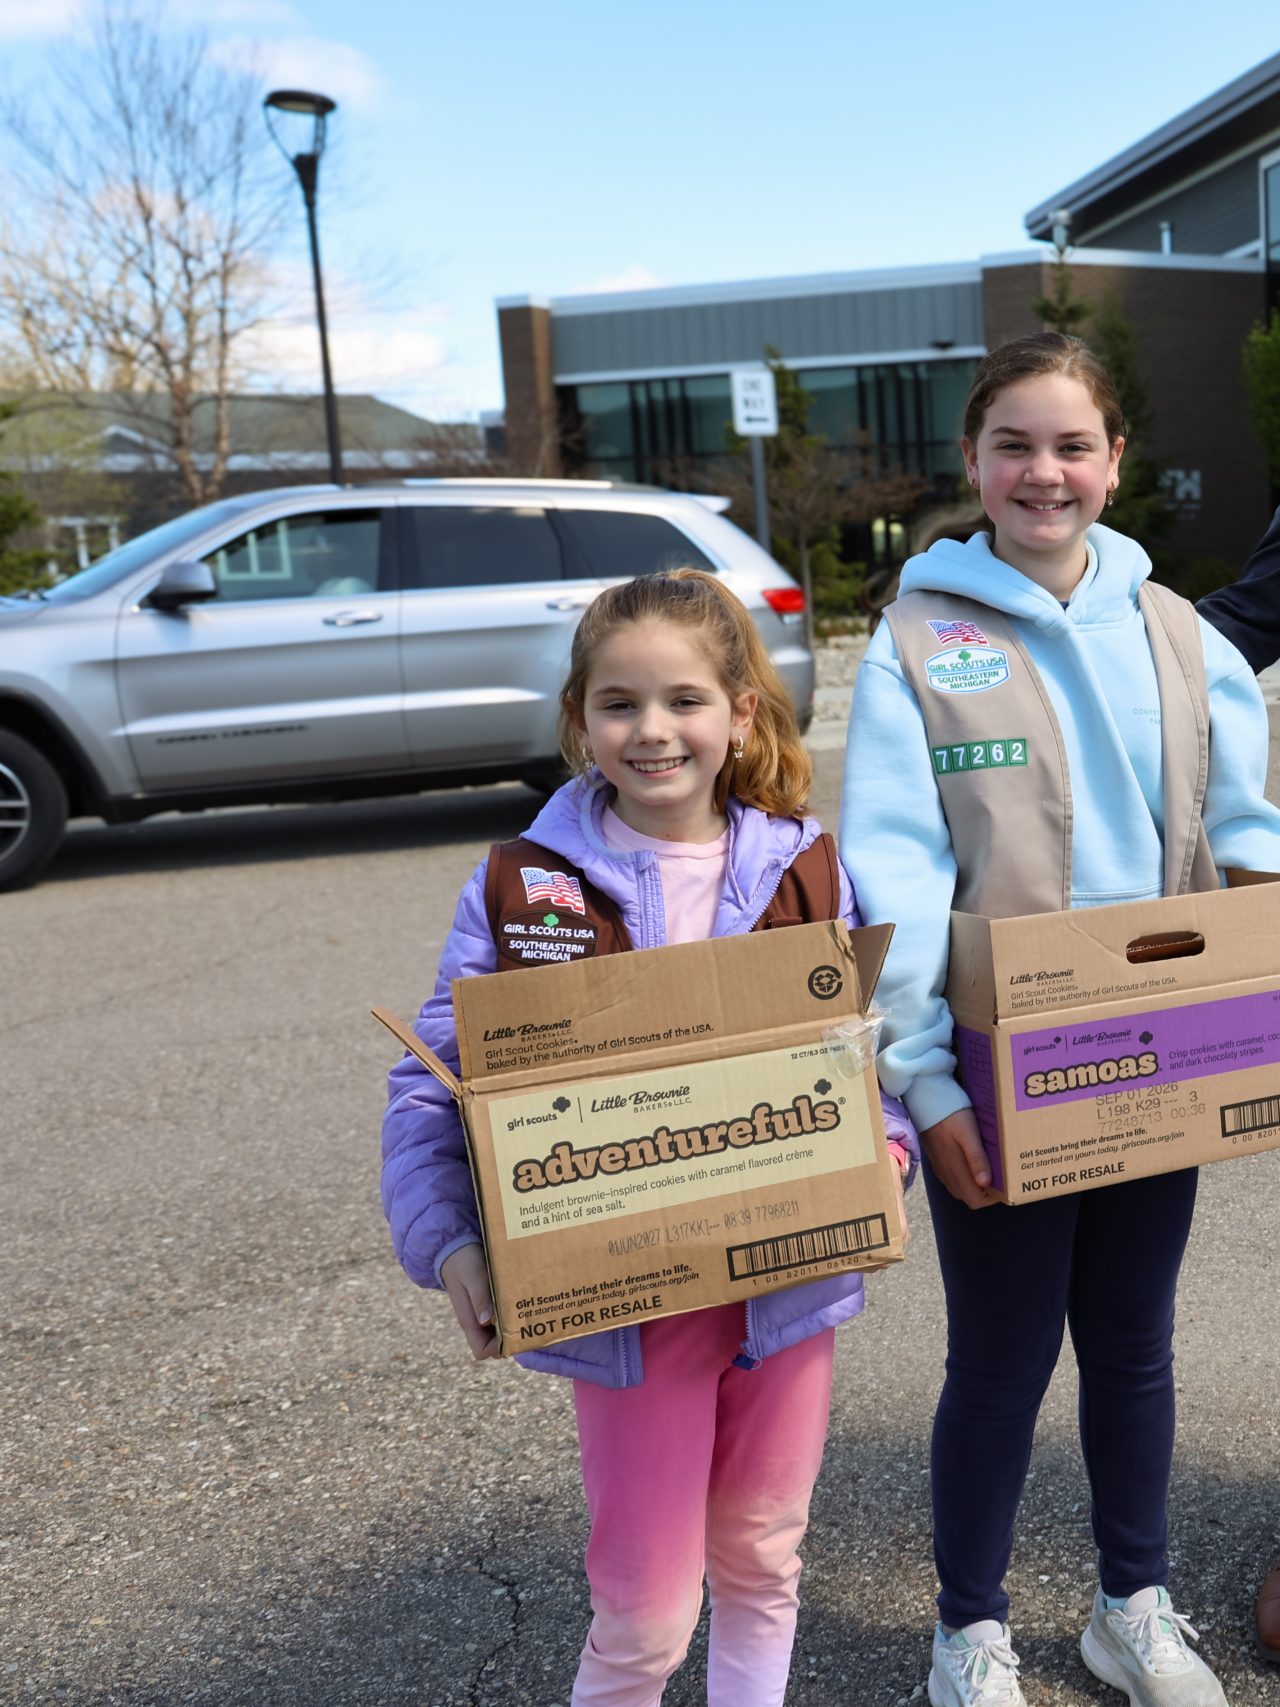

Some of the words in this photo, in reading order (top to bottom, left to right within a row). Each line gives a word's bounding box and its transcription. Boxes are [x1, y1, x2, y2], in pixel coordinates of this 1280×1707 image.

[929, 664, 948, 672] GIRL
[950, 660, 985, 670] SCOUTS
[987, 657, 1004, 665] USA
[938, 671, 999, 684] SOUTHEASTERN
[950, 680, 990, 689] MICHIGAN
[936, 742, 1024, 770] 77262
[504, 924, 527, 935] GIRL
[529, 926, 572, 938] SCOUTS
[574, 929, 594, 938] USA
[509, 940, 584, 953] SOUTHEASTERN
[522, 950, 571, 961] MICHIGAN
[1010, 974, 1033, 985] Little
[1034, 969, 1074, 981] Brownie
[1011, 999, 1033, 1009] baked
[1035, 998, 1044, 1006] by
[1045, 995, 1057, 1003] the
[1060, 990, 1095, 1002] authority
[1093, 988, 1100, 996] of
[1102, 986, 1114, 994] Girl
[1115, 983, 1139, 992] Scouts
[1140, 980, 1148, 988] of
[1149, 978, 1160, 986] the
[1162, 976, 1178, 985] USA.
[1011, 991, 1024, 1000] Girl
[1026, 988, 1046, 997] Scout
[483, 1027, 516, 1042] Little
[517, 1019, 572, 1036] Brownie
[1073, 1035, 1094, 1046] Little
[1095, 1029, 1132, 1041] Brownie
[486, 1050, 502, 1060] Girl
[505, 1045, 534, 1056] Scout
[487, 1056, 517, 1070] baked
[520, 1054, 531, 1065] by
[534, 1051, 550, 1062] the
[552, 1043, 595, 1060] authority
[598, 1041, 608, 1051] of
[610, 1038, 626, 1048] Girl
[628, 1033, 661, 1046] Scouts
[663, 1029, 673, 1038] of
[675, 1027, 690, 1037] the
[693, 1023, 714, 1034] USA.
[1024, 1045, 1035, 1055] girl
[1036, 1044, 1056, 1052] scouts
[1169, 1050, 1187, 1060] Crisp
[1190, 1044, 1217, 1056] cookies
[1219, 1041, 1234, 1051] with
[1236, 1034, 1266, 1047] caramel,
[1169, 1058, 1183, 1070] and
[1186, 1057, 1201, 1067] dark
[1204, 1050, 1237, 1064] chocolaty
[1240, 1046, 1264, 1057] stripes
[1024, 1051, 1158, 1098] samoas
[591, 1098, 627, 1113] Little
[629, 1085, 690, 1105] Brownie
[1096, 1091, 1122, 1106] SEP
[1127, 1089, 1141, 1100] 01
[1147, 1081, 1178, 1097] 2026
[507, 1118, 524, 1131] girl
[527, 1112, 558, 1125] scouts
[1020, 1151, 1033, 1159] Girl
[1035, 1145, 1059, 1156] Scouts
[1061, 1141, 1079, 1151] bring
[1080, 1138, 1097, 1147] their
[1099, 1133, 1124, 1144] dreams
[1135, 1128, 1147, 1136] life.
[1021, 1162, 1034, 1170] Get
[1036, 1156, 1063, 1168] started
[1075, 1150, 1096, 1161] yours
[1097, 1145, 1120, 1155] today.
[520, 1200, 565, 1216] Indulgent
[567, 1181, 648, 1205] brownie-inspired
[650, 1174, 686, 1189] cookies
[688, 1168, 707, 1182] with
[710, 1161, 746, 1177] caramel
[748, 1154, 783, 1169] flavored
[786, 1149, 814, 1162] crème
[1022, 1178, 1048, 1193] NOT
[1052, 1172, 1076, 1186] FOR
[1080, 1161, 1125, 1180] RESALE
[521, 1215, 540, 1229] and
[552, 1209, 570, 1223] hint
[573, 1206, 582, 1218] of
[586, 1206, 603, 1216] sea
[605, 1200, 626, 1212] salt.
[786, 1266, 818, 1278] 82011
[515, 1300, 534, 1310] Girl
[537, 1292, 570, 1305] Scouts
[572, 1284, 598, 1297] bring
[600, 1279, 623, 1291] their
[625, 1271, 660, 1286] dreams
[662, 1268, 672, 1276] to
[674, 1263, 692, 1274] life.
[518, 1309, 533, 1319] Get
[535, 1302, 564, 1316] started
[577, 1295, 600, 1308] yours
[602, 1290, 627, 1300] today.
[520, 1320, 556, 1339] NOT
[561, 1311, 595, 1330] FOR
[600, 1295, 662, 1320] RESALE
